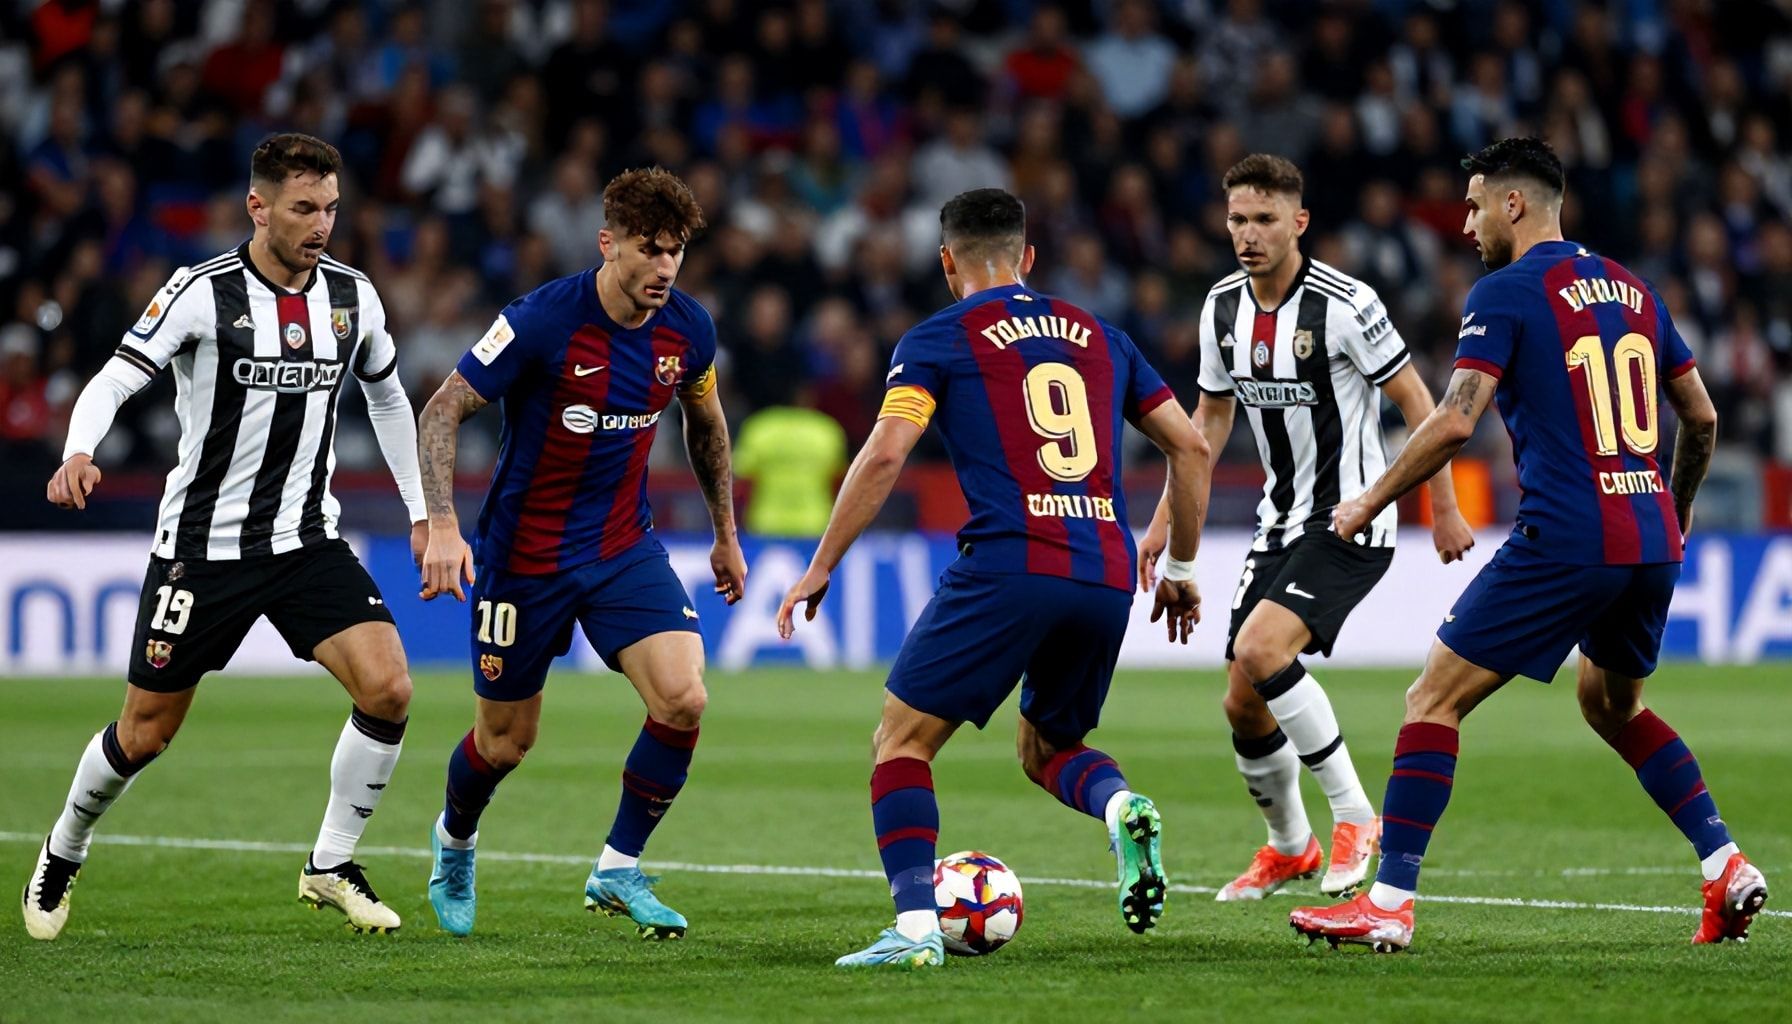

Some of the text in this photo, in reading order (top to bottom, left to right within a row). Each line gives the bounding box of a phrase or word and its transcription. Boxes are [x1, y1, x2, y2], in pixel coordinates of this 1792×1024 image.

[1022, 362, 1098, 482] 9
[1565, 332, 1658, 456] 10
[151, 585, 194, 635] 19
[476, 600, 517, 647] 10
